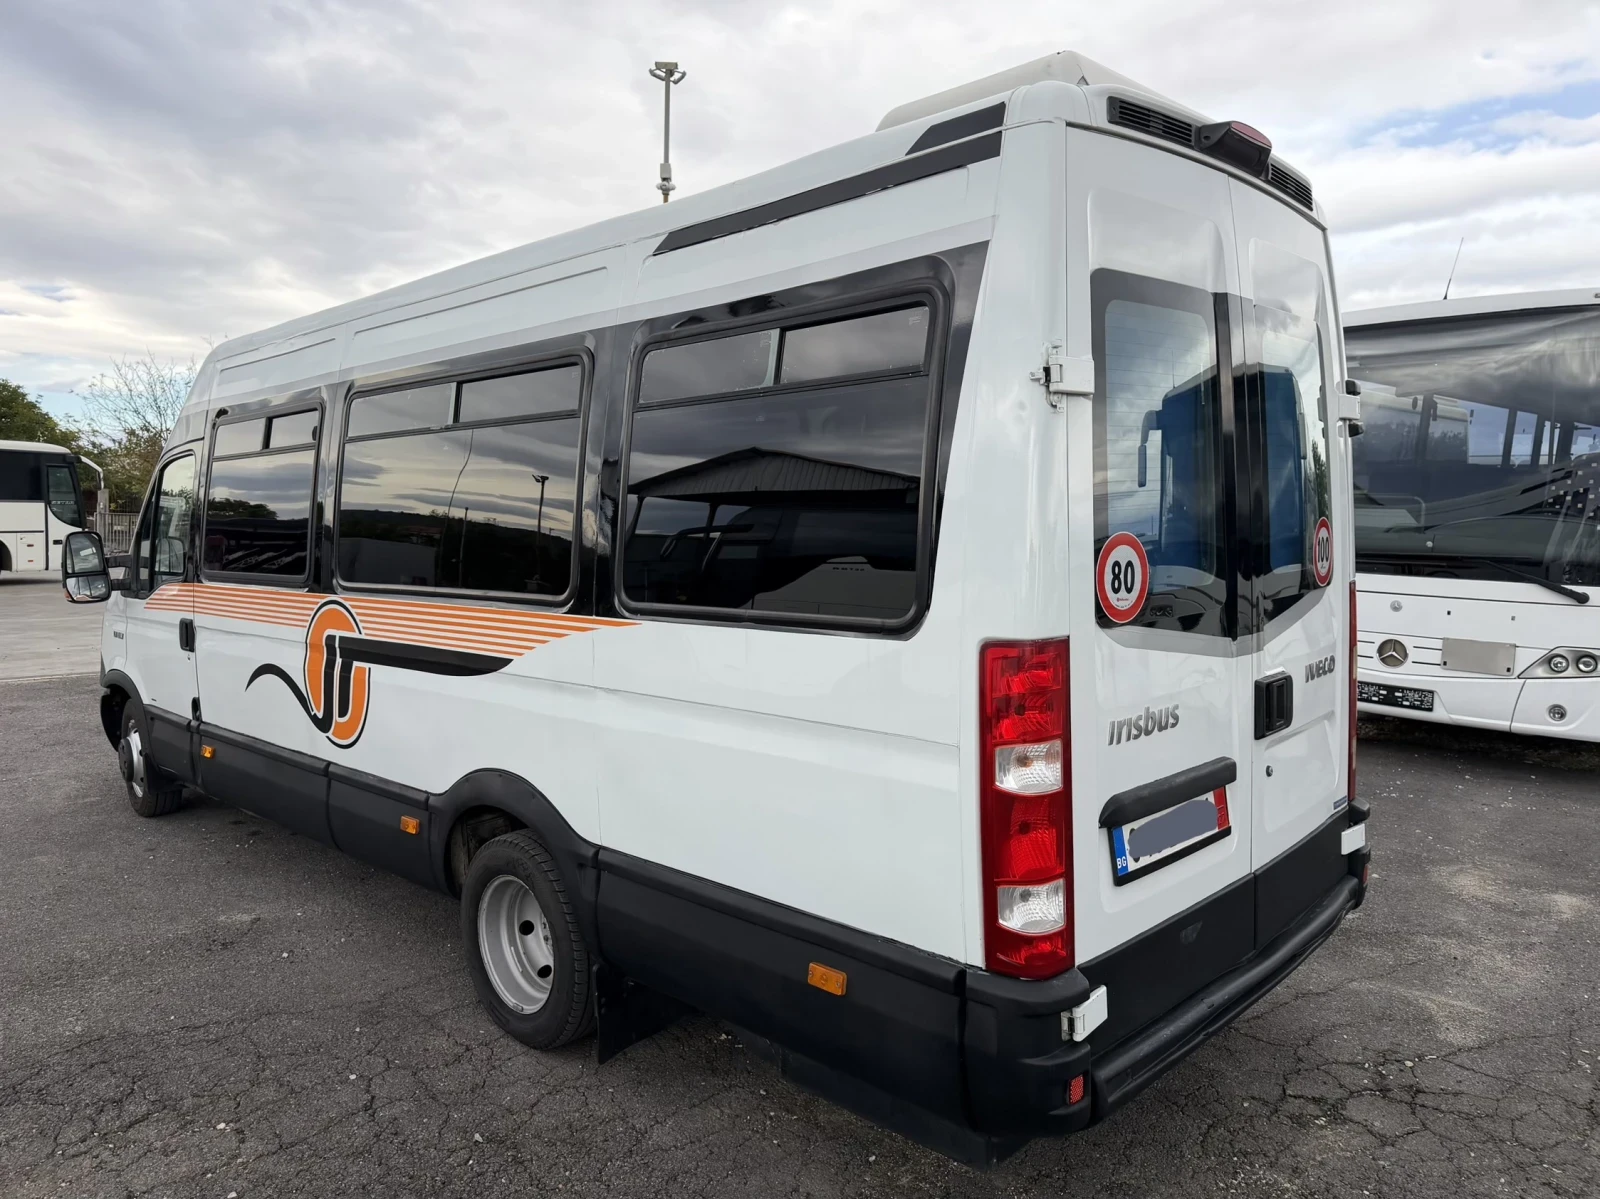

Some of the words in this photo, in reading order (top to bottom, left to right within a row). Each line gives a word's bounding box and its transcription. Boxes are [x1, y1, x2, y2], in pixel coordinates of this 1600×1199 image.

[1317, 536, 1330, 563] 100
[1111, 560, 1135, 594] 80
[1304, 654, 1336, 684] IVECO
[1116, 856, 1127, 869] BG
